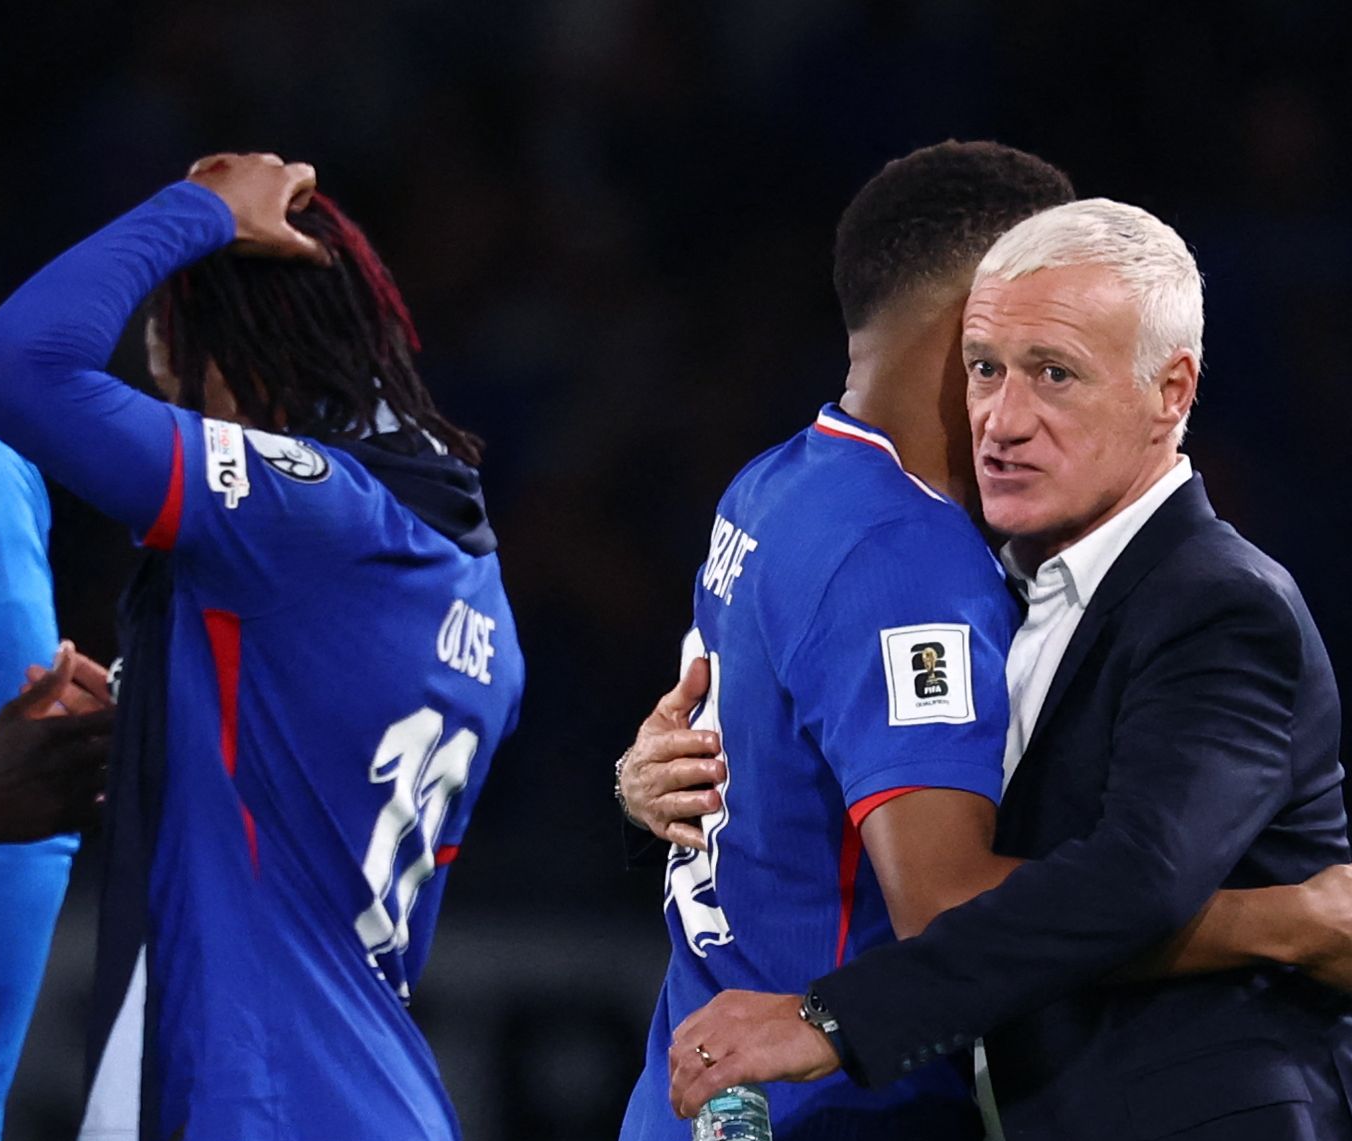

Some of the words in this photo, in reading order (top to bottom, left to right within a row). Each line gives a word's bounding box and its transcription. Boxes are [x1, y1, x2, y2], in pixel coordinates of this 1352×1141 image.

[436, 599, 495, 685] OLISE
[924, 684, 942, 695] FIFA
[354, 706, 478, 1007] 11
